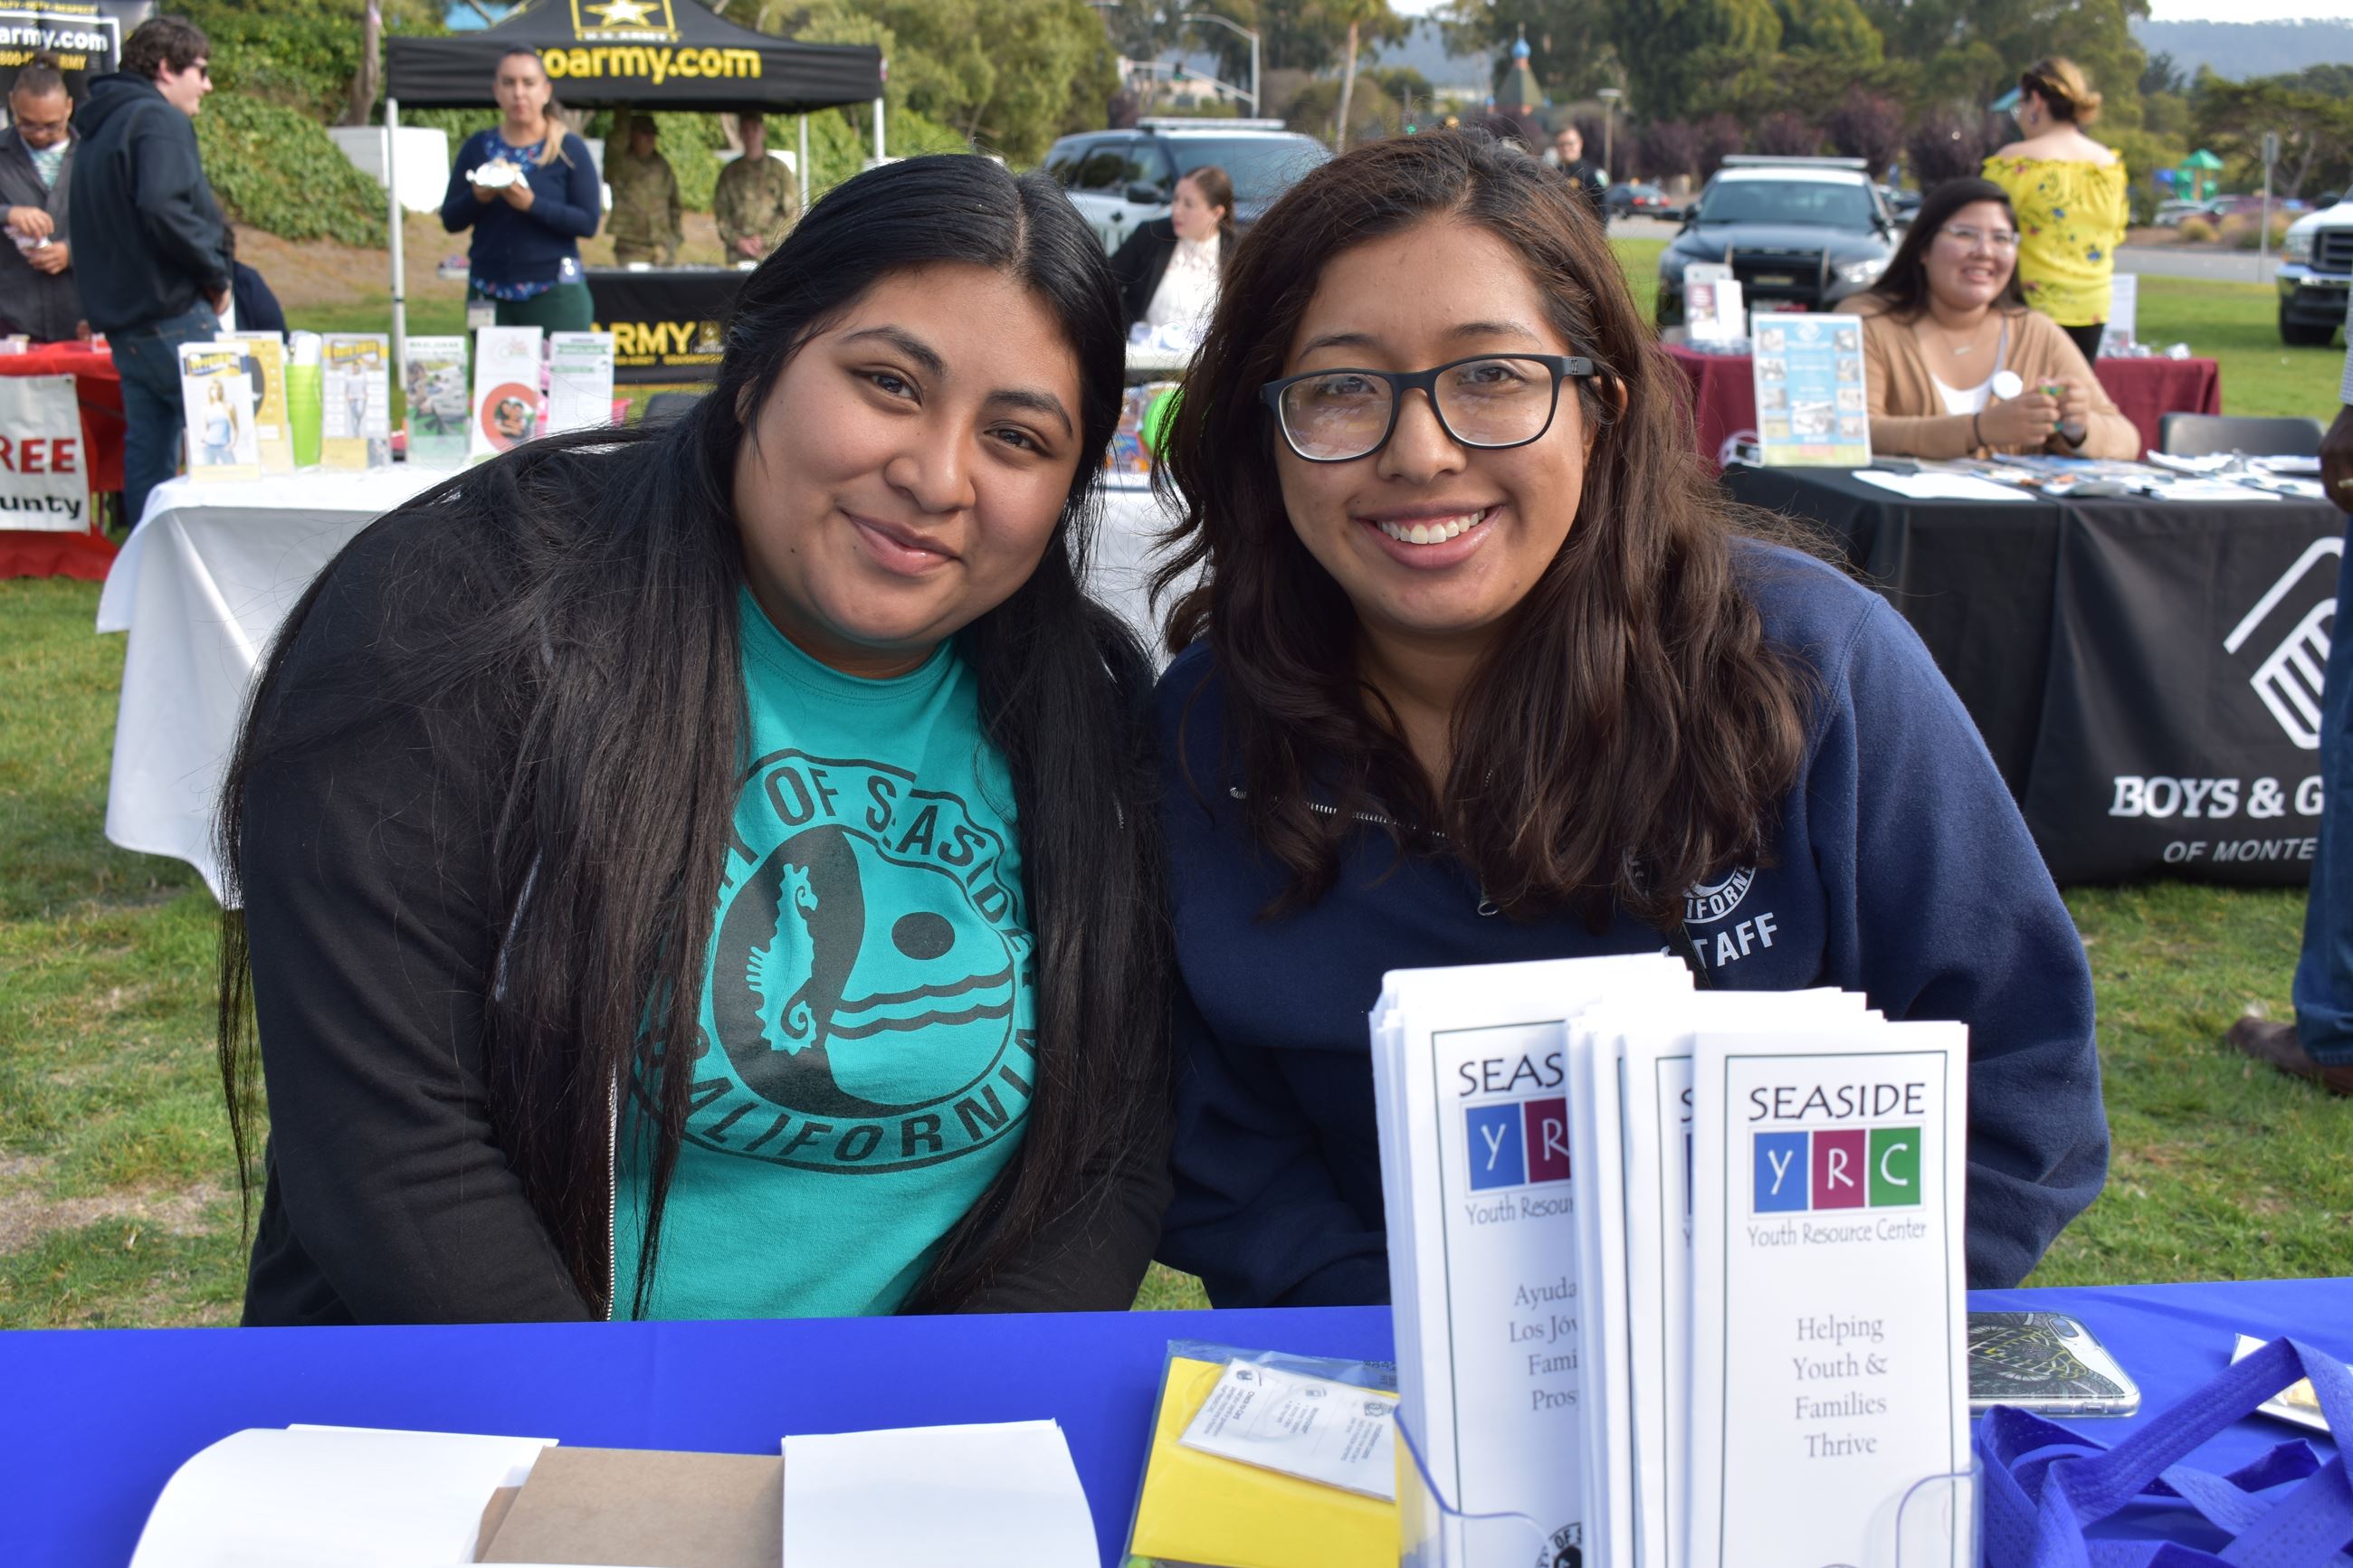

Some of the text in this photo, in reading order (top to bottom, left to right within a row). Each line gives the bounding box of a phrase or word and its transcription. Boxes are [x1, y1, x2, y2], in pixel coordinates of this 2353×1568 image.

[536, 46, 762, 85] oarmy.com
[2108, 775, 2240, 818] BOYS
[2246, 776, 2286, 819] &
[764, 766, 839, 827] OF
[865, 774, 1032, 953] SASID
[2163, 837, 2319, 863] OF MONTE
[1459, 1051, 1565, 1098] SEAS
[1748, 1083, 1926, 1122] SEASIDE
[1464, 1193, 1516, 1226] Youth
[1747, 1217, 1927, 1248] Youth Resource Center
[1509, 1320, 1545, 1344] Los
[1796, 1314, 1885, 1346] Helping
[1528, 1348, 1578, 1376] Fami
[1792, 1352, 1889, 1381] Youth &
[1531, 1389, 1579, 1411] Pros
[1795, 1391, 1887, 1421] Families
[1803, 1432, 1878, 1459] Thrive
